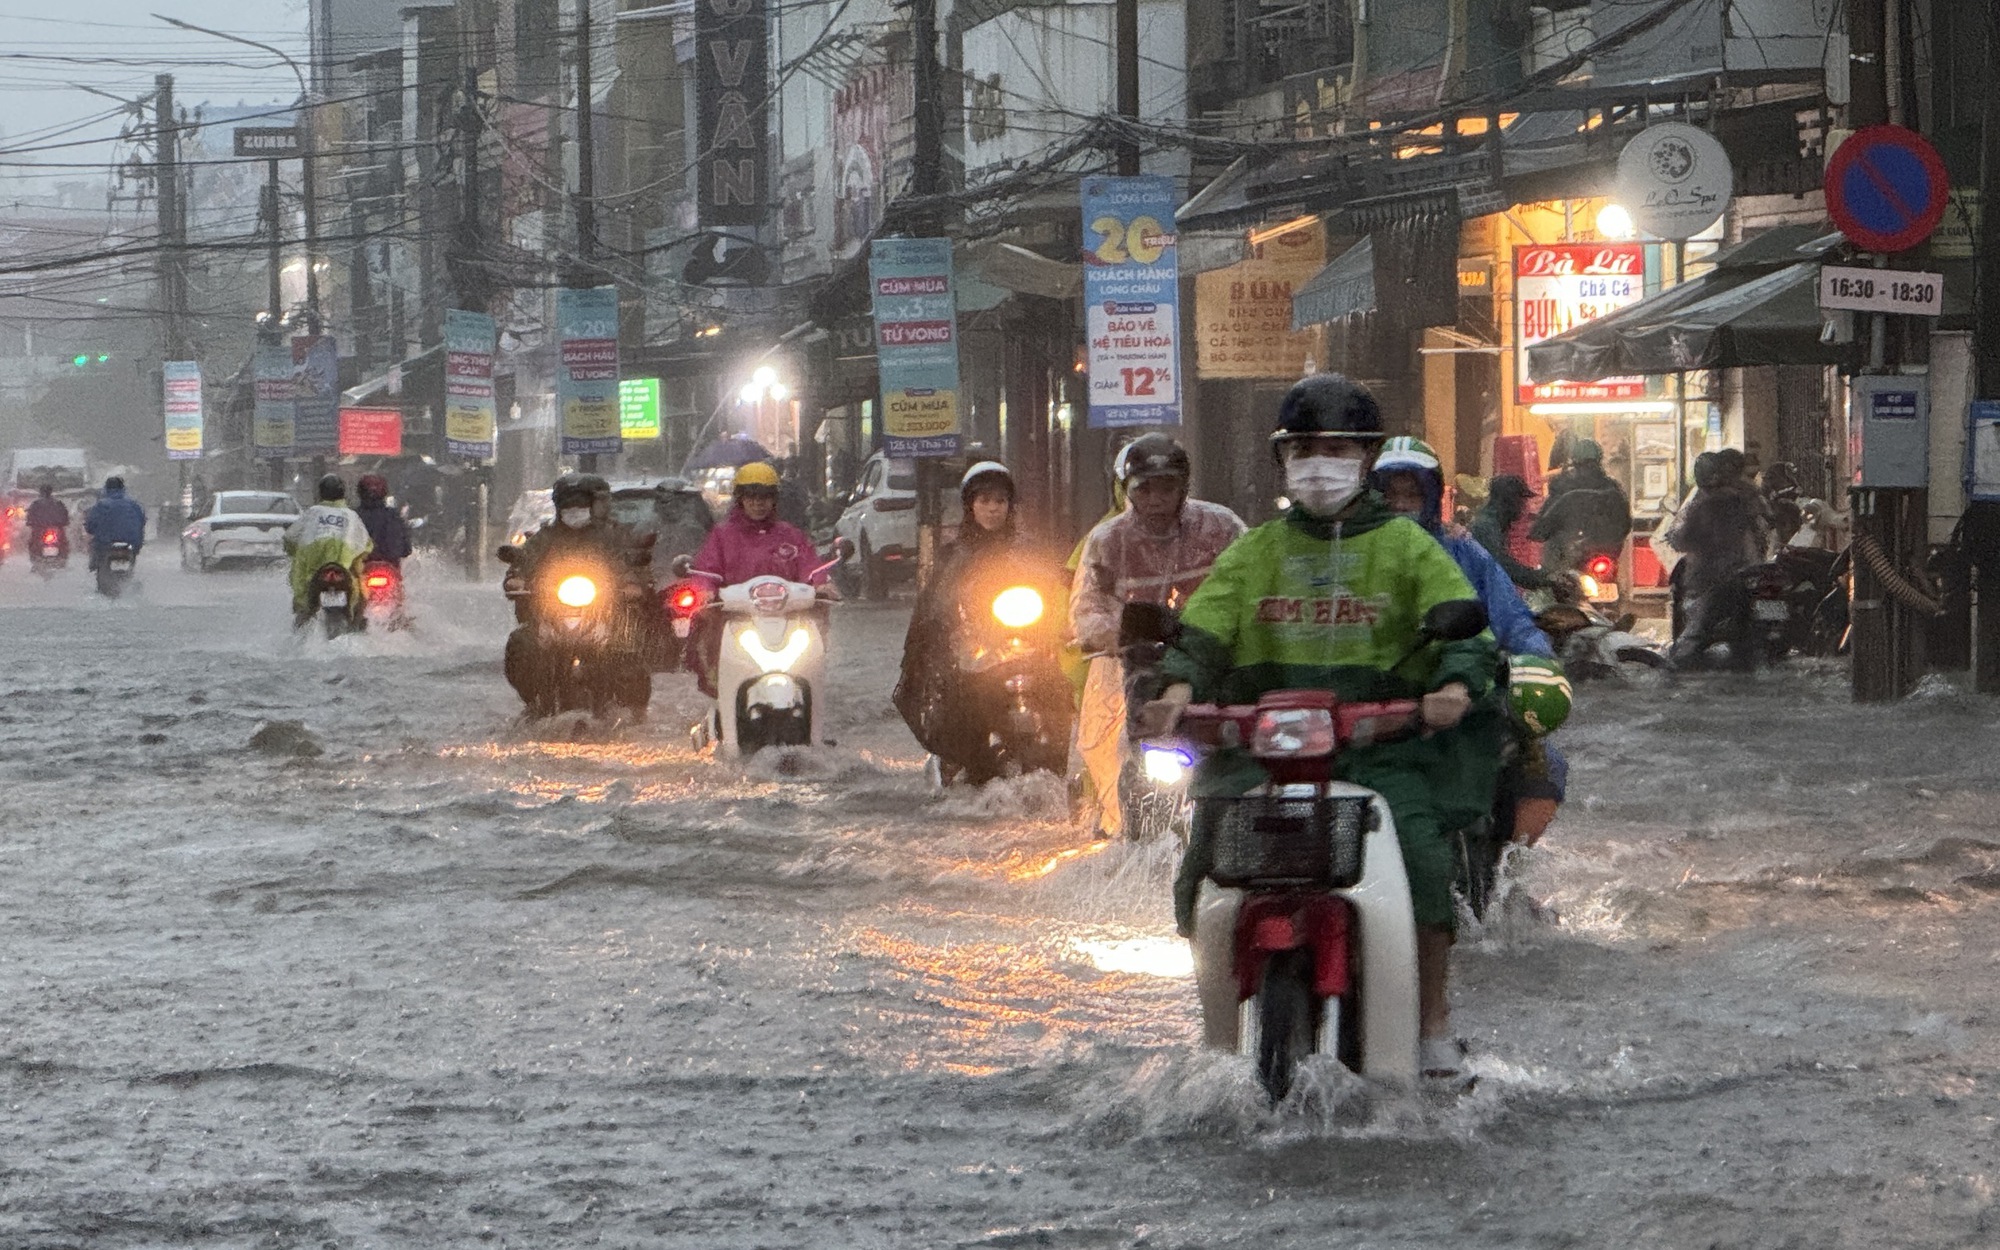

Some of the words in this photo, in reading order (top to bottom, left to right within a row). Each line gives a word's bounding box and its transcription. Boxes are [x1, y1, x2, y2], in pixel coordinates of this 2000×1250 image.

[710, 39, 756, 205] VÂN
[1690, 186, 1718, 207] Spa
[1090, 215, 1164, 264] 20
[1523, 250, 1575, 275] Bà
[1583, 249, 1637, 275] Lữ
[1088, 267, 1135, 281] KHÁCH
[1137, 265, 1175, 280] HÀNG
[1101, 284, 1129, 295] LONG
[1130, 282, 1161, 294] CHÂU
[1579, 278, 1606, 297] Chả
[1612, 279, 1630, 296] Cá
[1830, 277, 1874, 299] 16:30
[1891, 281, 1934, 304] 18:30
[905, 326, 950, 341] VONG
[1108, 318, 1136, 332] BẢO
[1113, 334, 1140, 348] TIÊU
